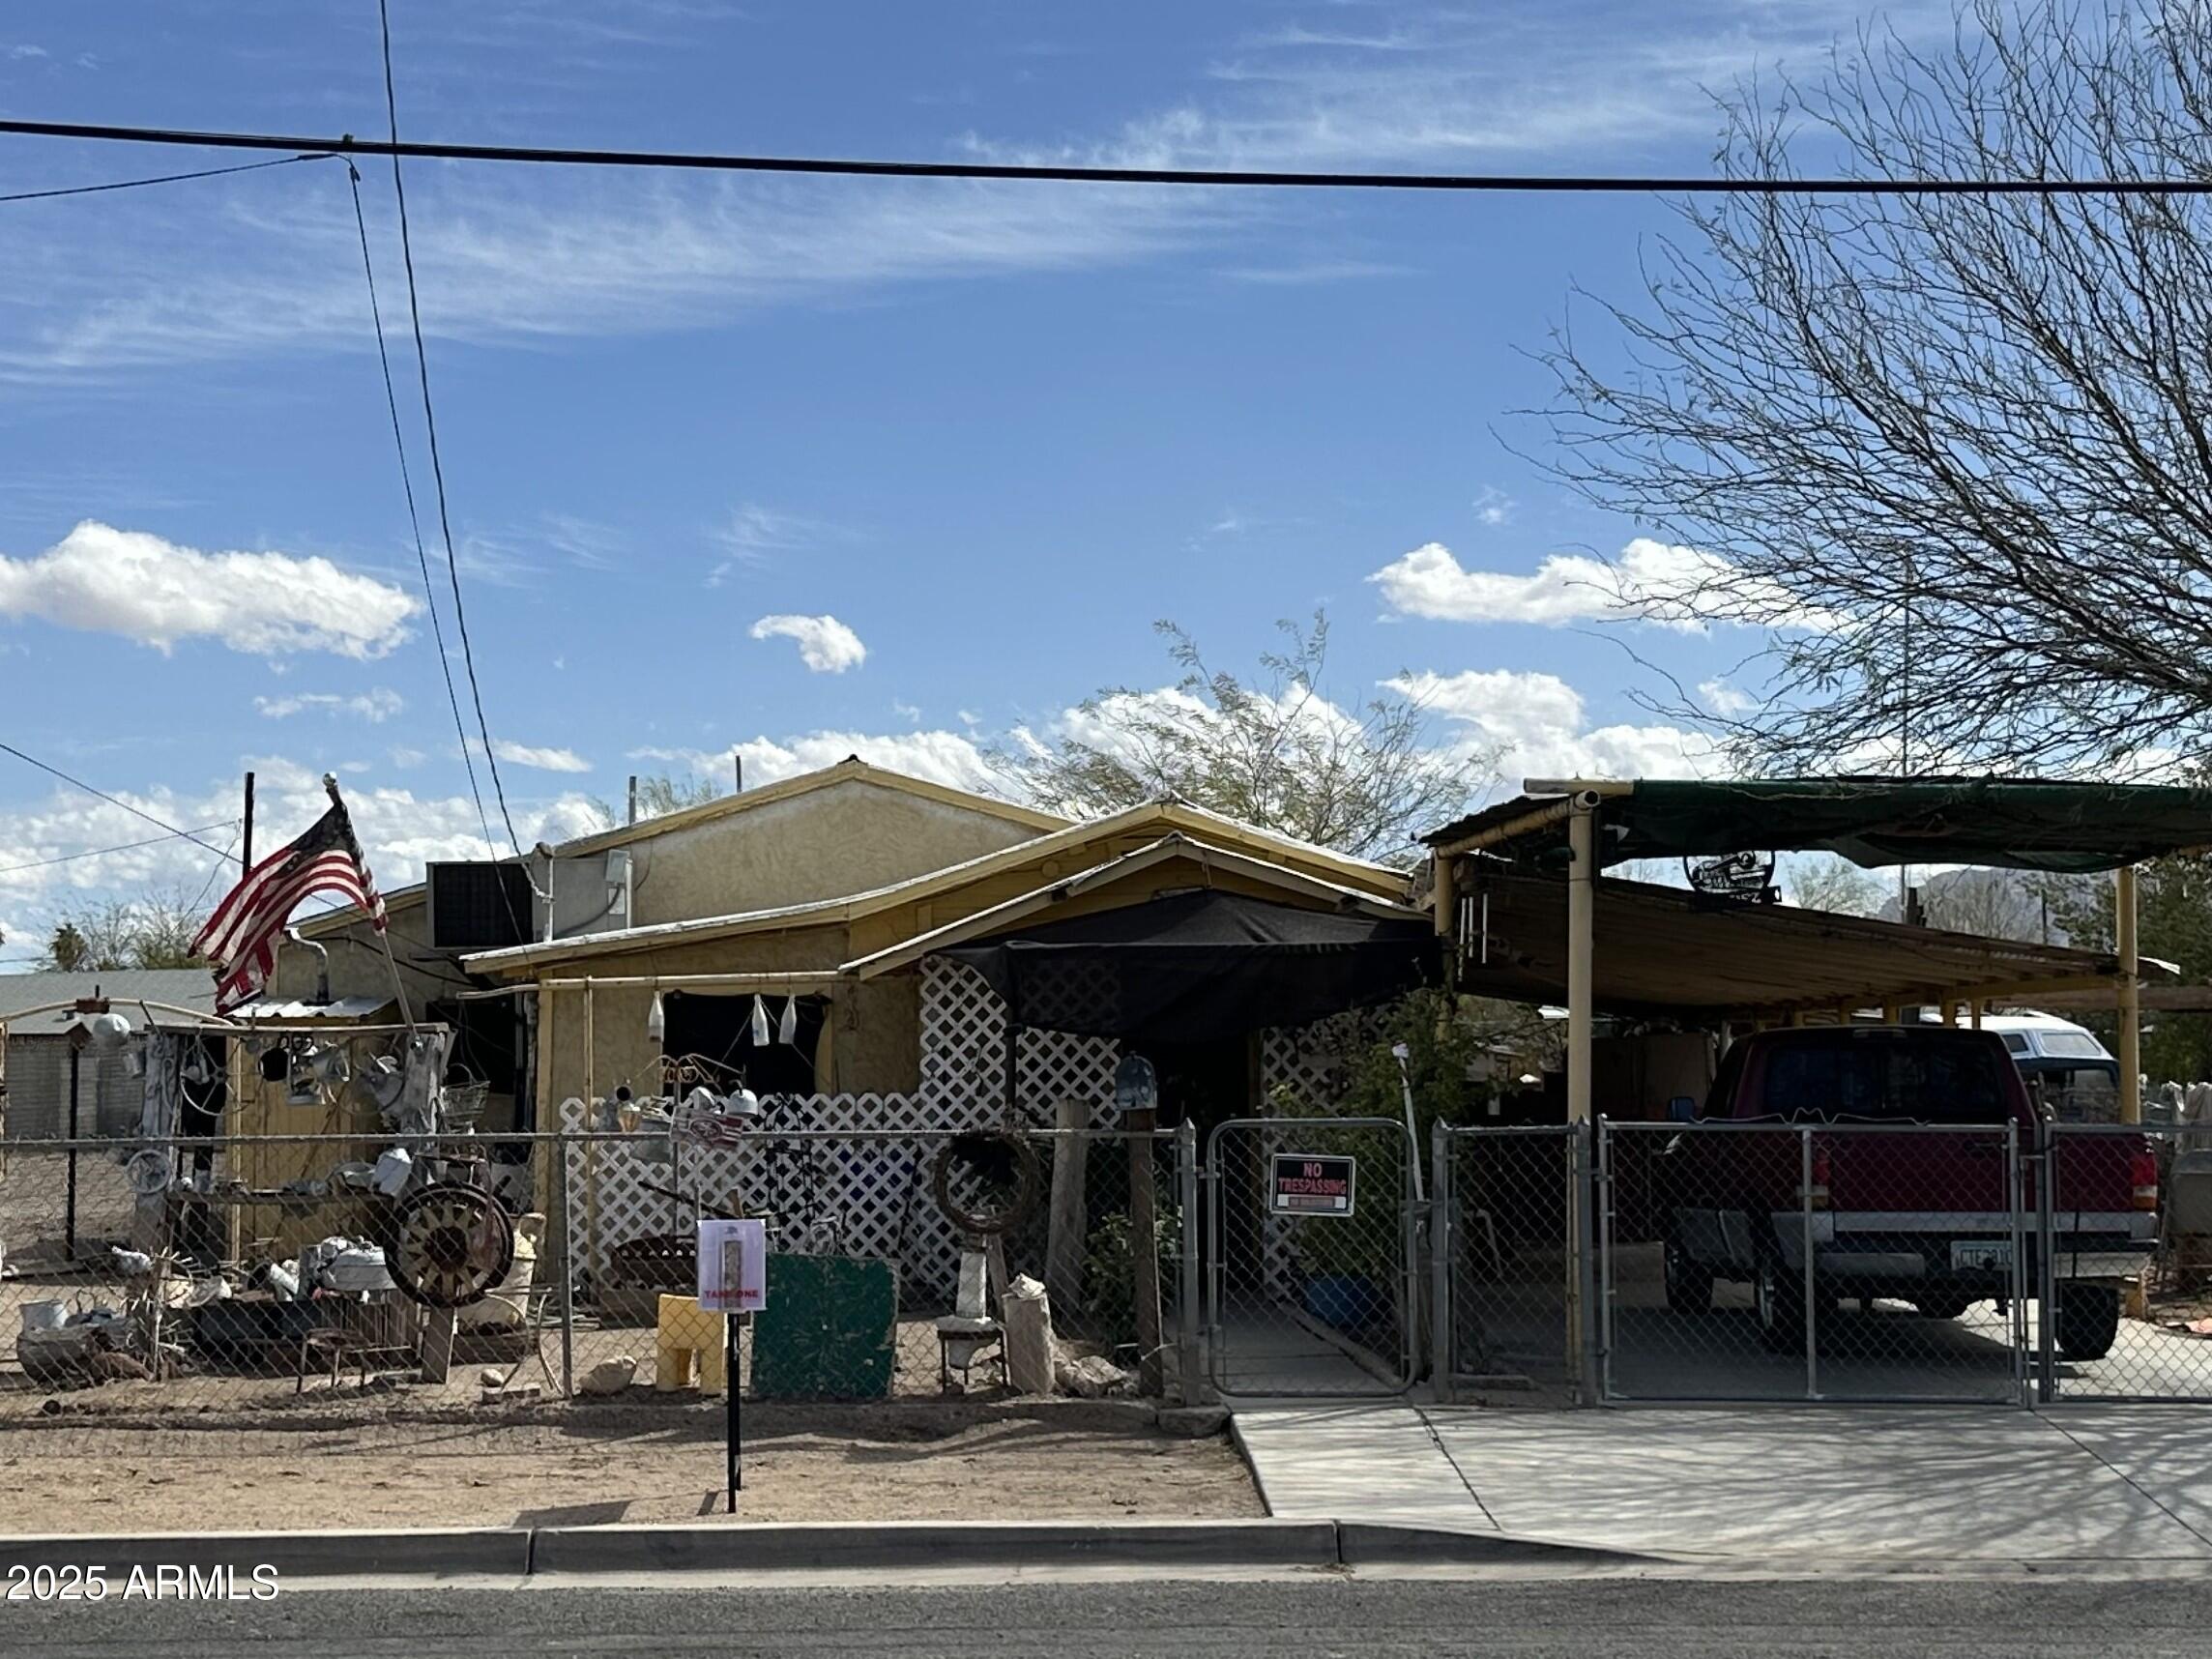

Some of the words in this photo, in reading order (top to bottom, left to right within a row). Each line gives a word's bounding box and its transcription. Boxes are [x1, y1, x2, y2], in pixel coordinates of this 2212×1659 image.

[1303, 1162, 1323, 1178] NO
[1278, 1178, 1347, 1194] TRESPASSING
[736, 1290, 759, 1299] ONE
